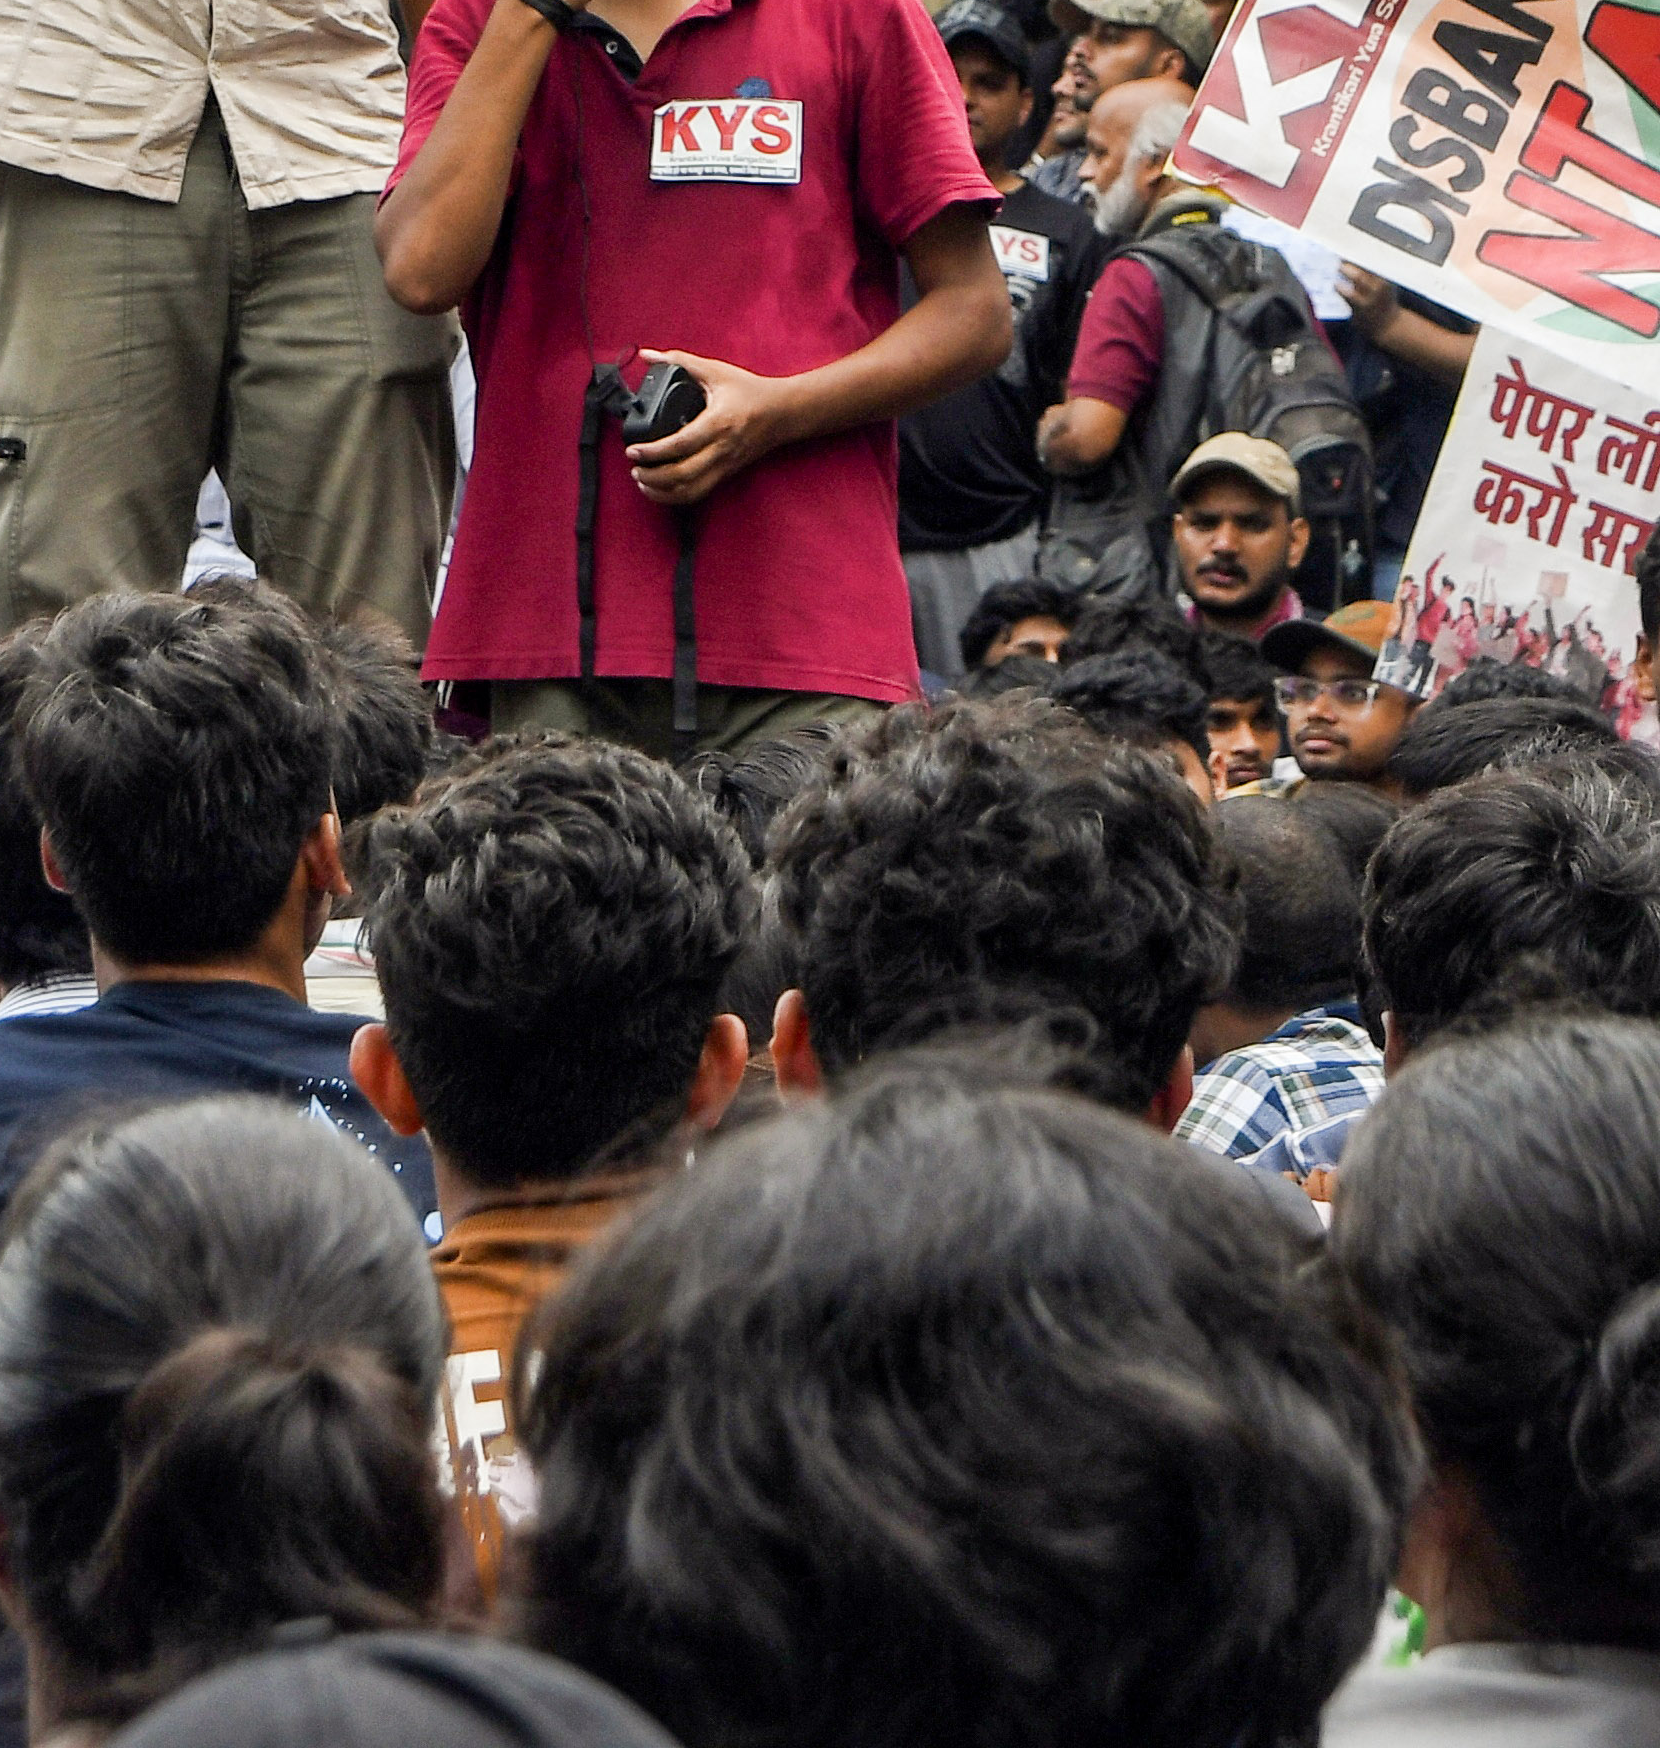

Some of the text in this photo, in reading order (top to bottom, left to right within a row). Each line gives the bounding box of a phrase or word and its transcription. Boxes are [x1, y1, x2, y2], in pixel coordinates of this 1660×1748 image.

[660, 105, 793, 155] KYS
[1311, 65, 1365, 158] Krantikari
[996, 232, 1040, 263] YS
[1490, 355, 1595, 463] पेपर
[1473, 459, 1578, 548] करो
